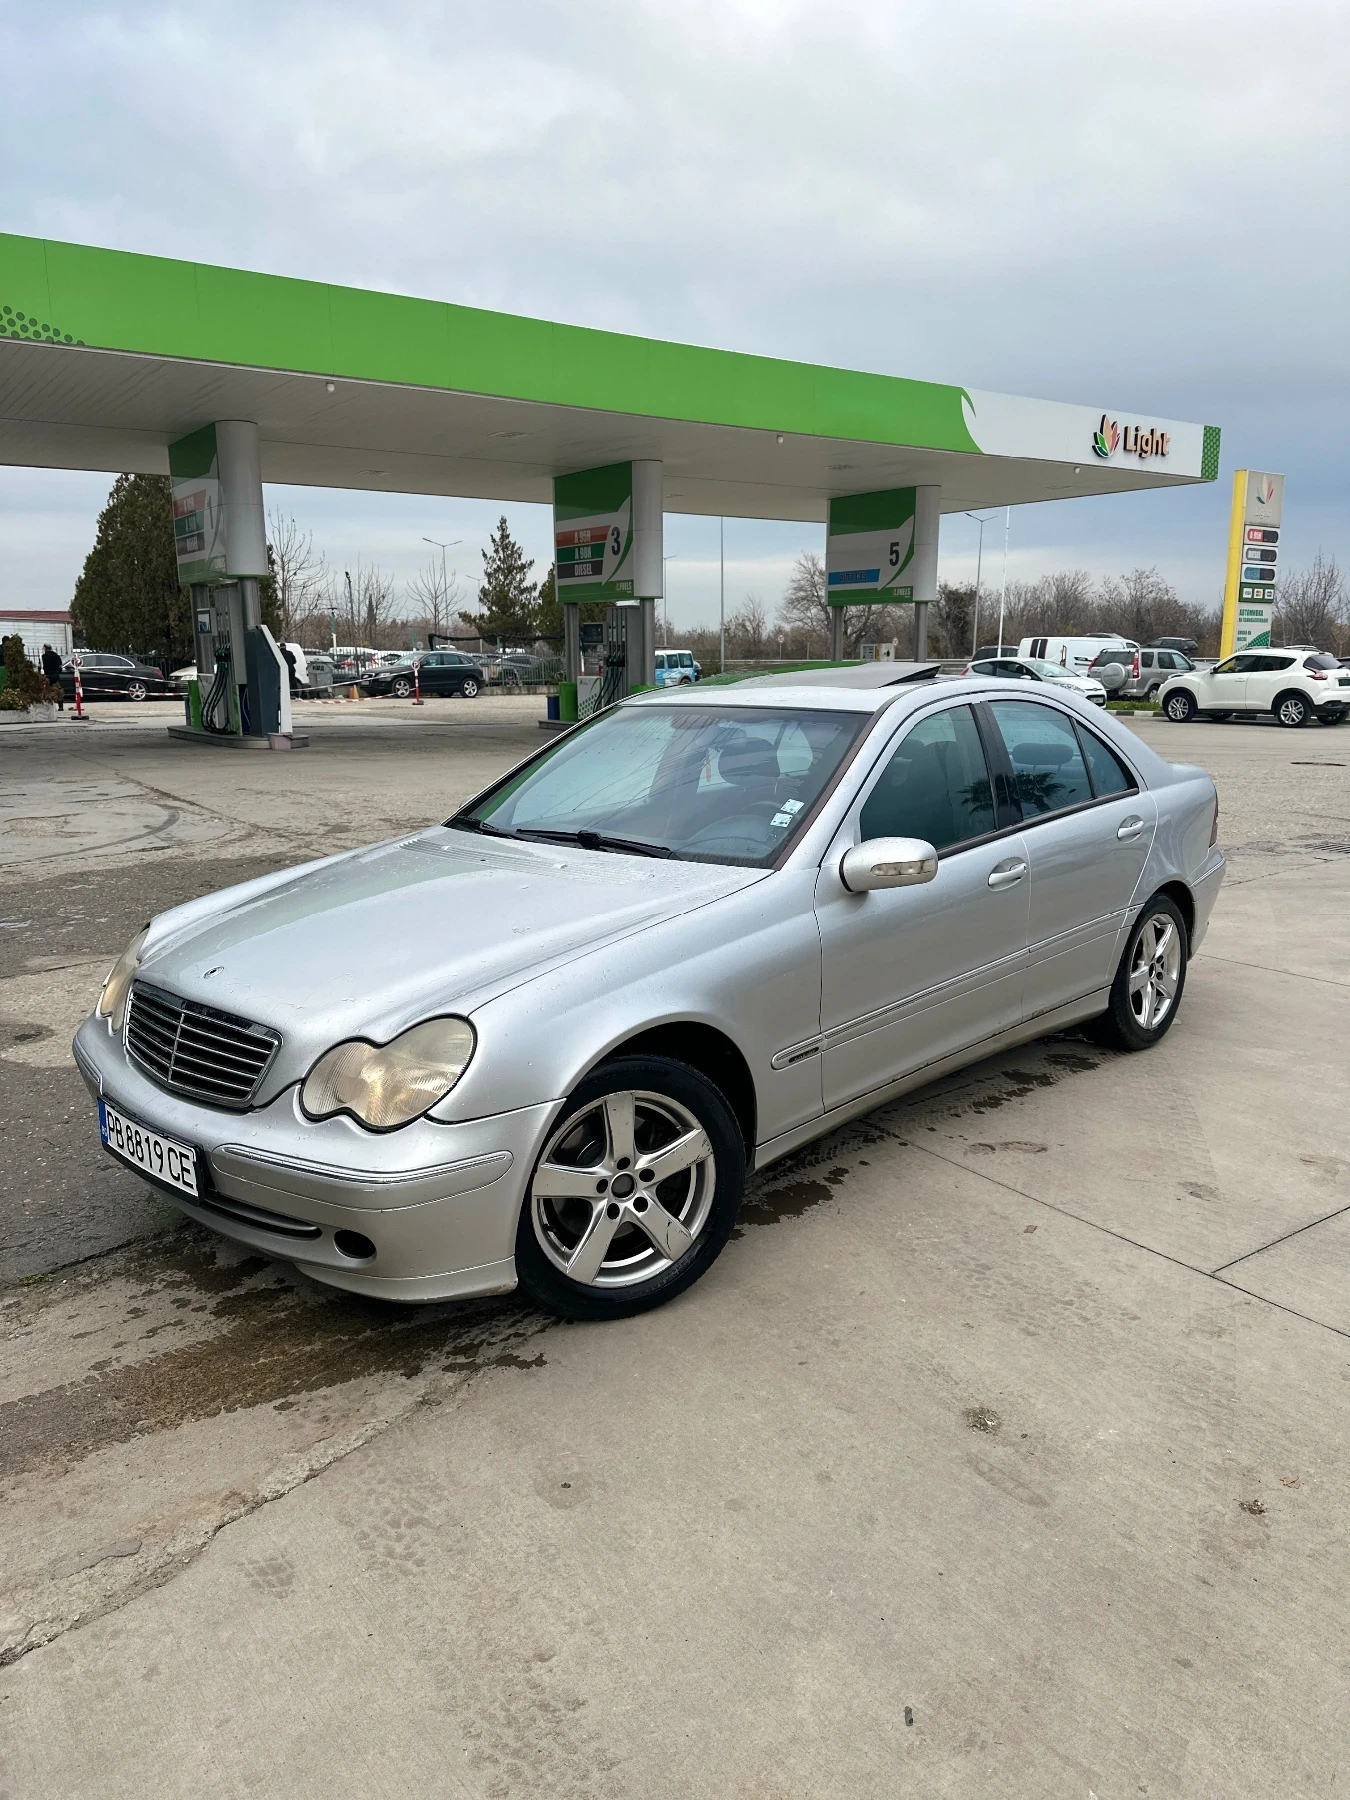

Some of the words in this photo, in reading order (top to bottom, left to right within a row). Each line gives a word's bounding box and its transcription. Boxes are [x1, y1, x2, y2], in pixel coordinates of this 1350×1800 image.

[1123, 425, 1171, 458] Light
[611, 527, 621, 556] 3
[889, 541, 900, 567] 5
[575, 564, 593, 576] DIESEL
[840, 573, 854, 582] AUTO
[856, 573, 867, 581] GAS
